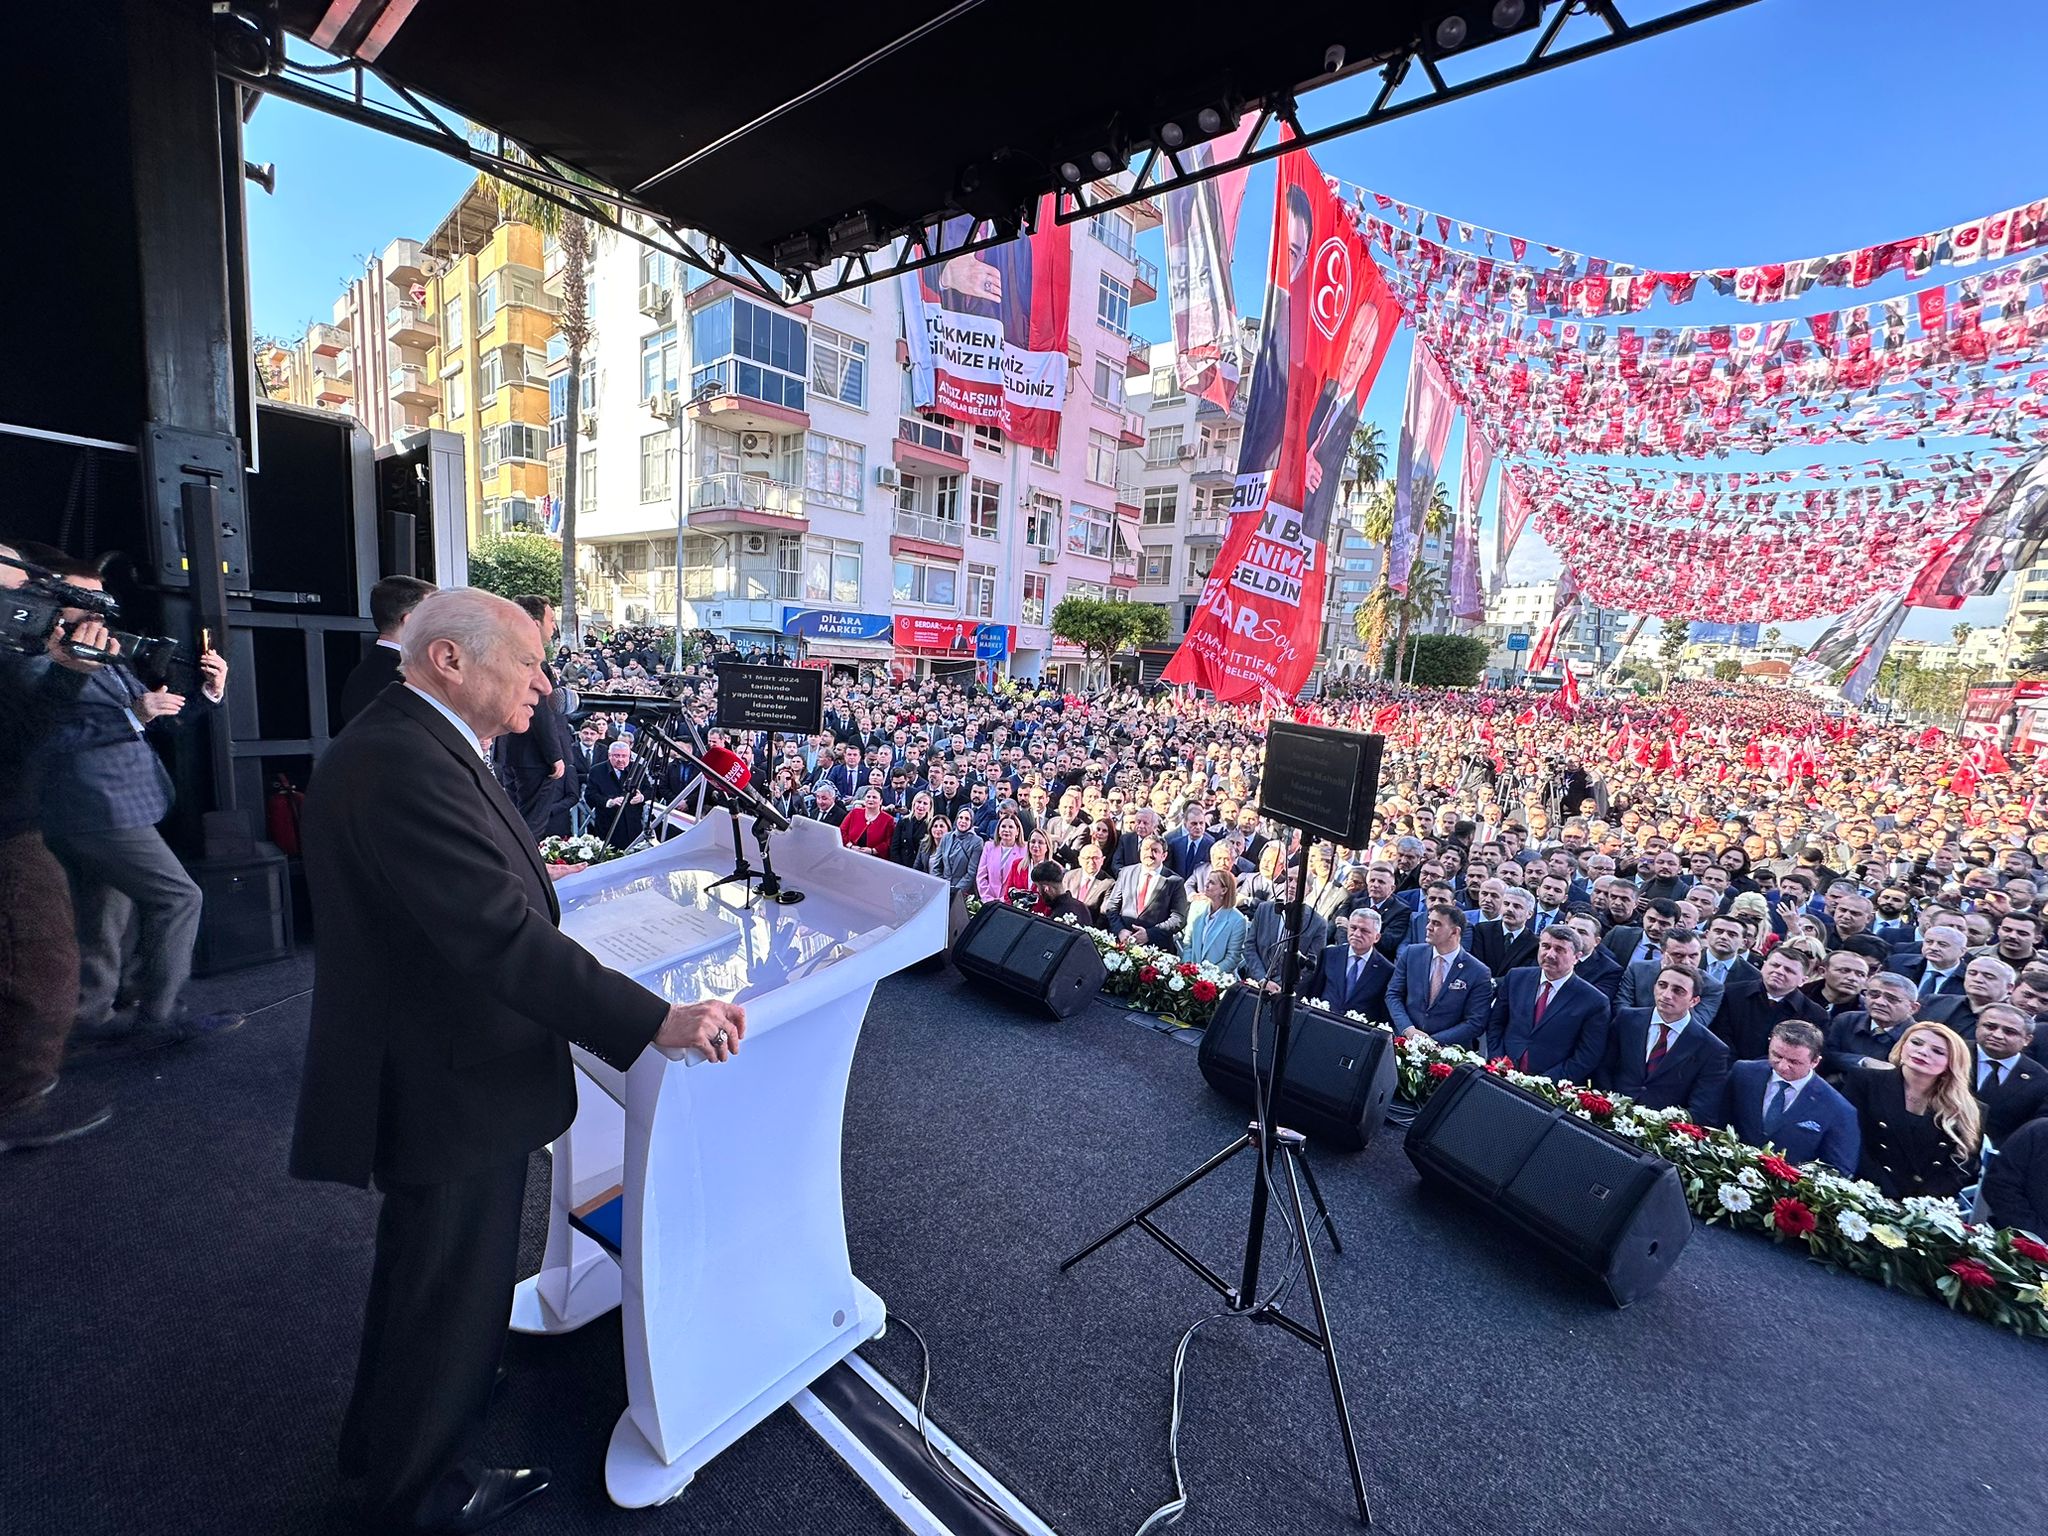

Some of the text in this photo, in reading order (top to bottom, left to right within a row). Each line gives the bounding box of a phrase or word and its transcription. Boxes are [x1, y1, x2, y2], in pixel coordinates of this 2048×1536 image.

[925, 315, 996, 349] TÜKMEN
[1003, 375, 1055, 398] ELDİNİZ
[962, 391, 998, 408] AFŞIN
[1245, 539, 1304, 578] İNİM
[13, 609, 28, 621] 2
[821, 613, 861, 626] DİLARA
[818, 624, 863, 634] MARKET
[914, 620, 939, 629] SERDAR
[755, 674, 776, 682] Mart
[731, 691, 808, 703] yapılacak Mahalli
